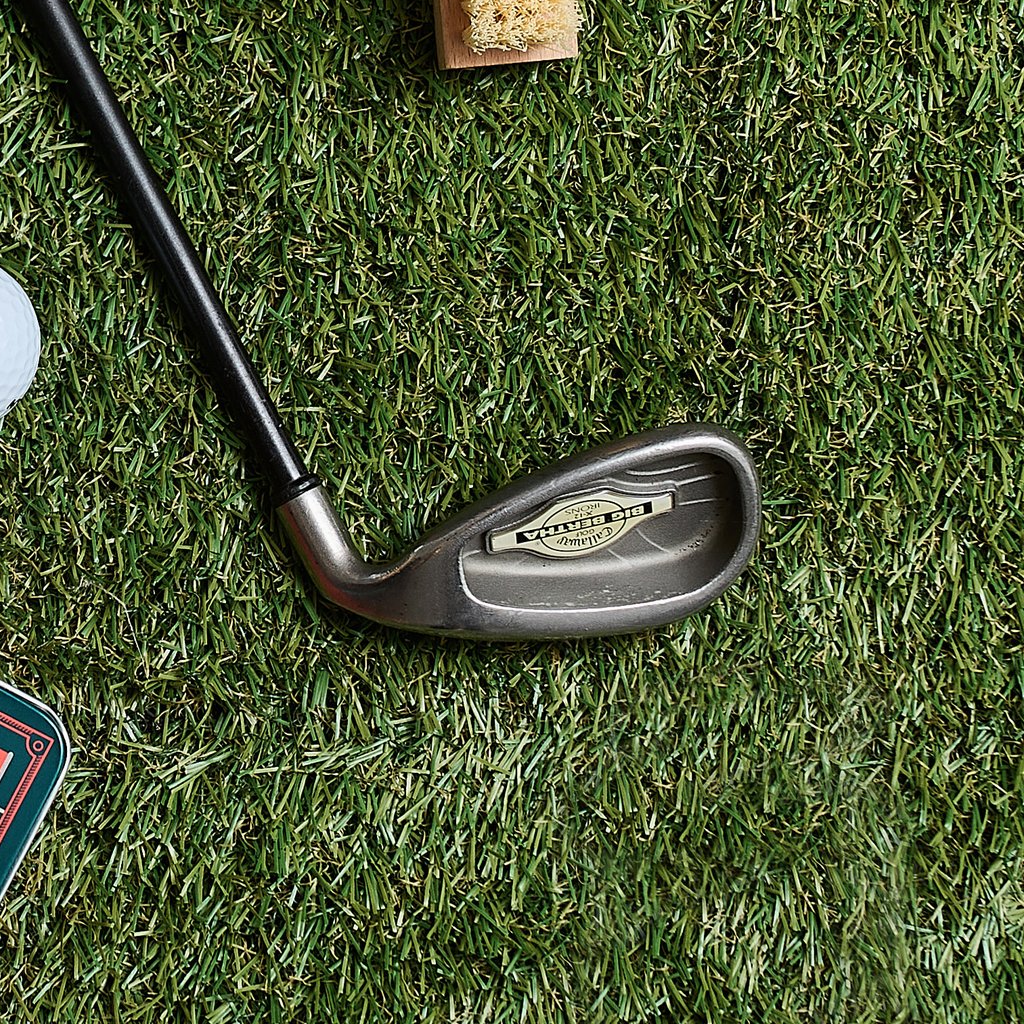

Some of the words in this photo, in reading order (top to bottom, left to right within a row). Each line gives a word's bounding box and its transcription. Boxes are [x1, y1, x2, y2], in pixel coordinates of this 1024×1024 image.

[564, 502, 601, 516] IRONS
[611, 504, 645, 520] BIG
[523, 515, 606, 541] BERTHA
[576, 529, 595, 537] GOLF
[555, 526, 613, 547] Callaway
